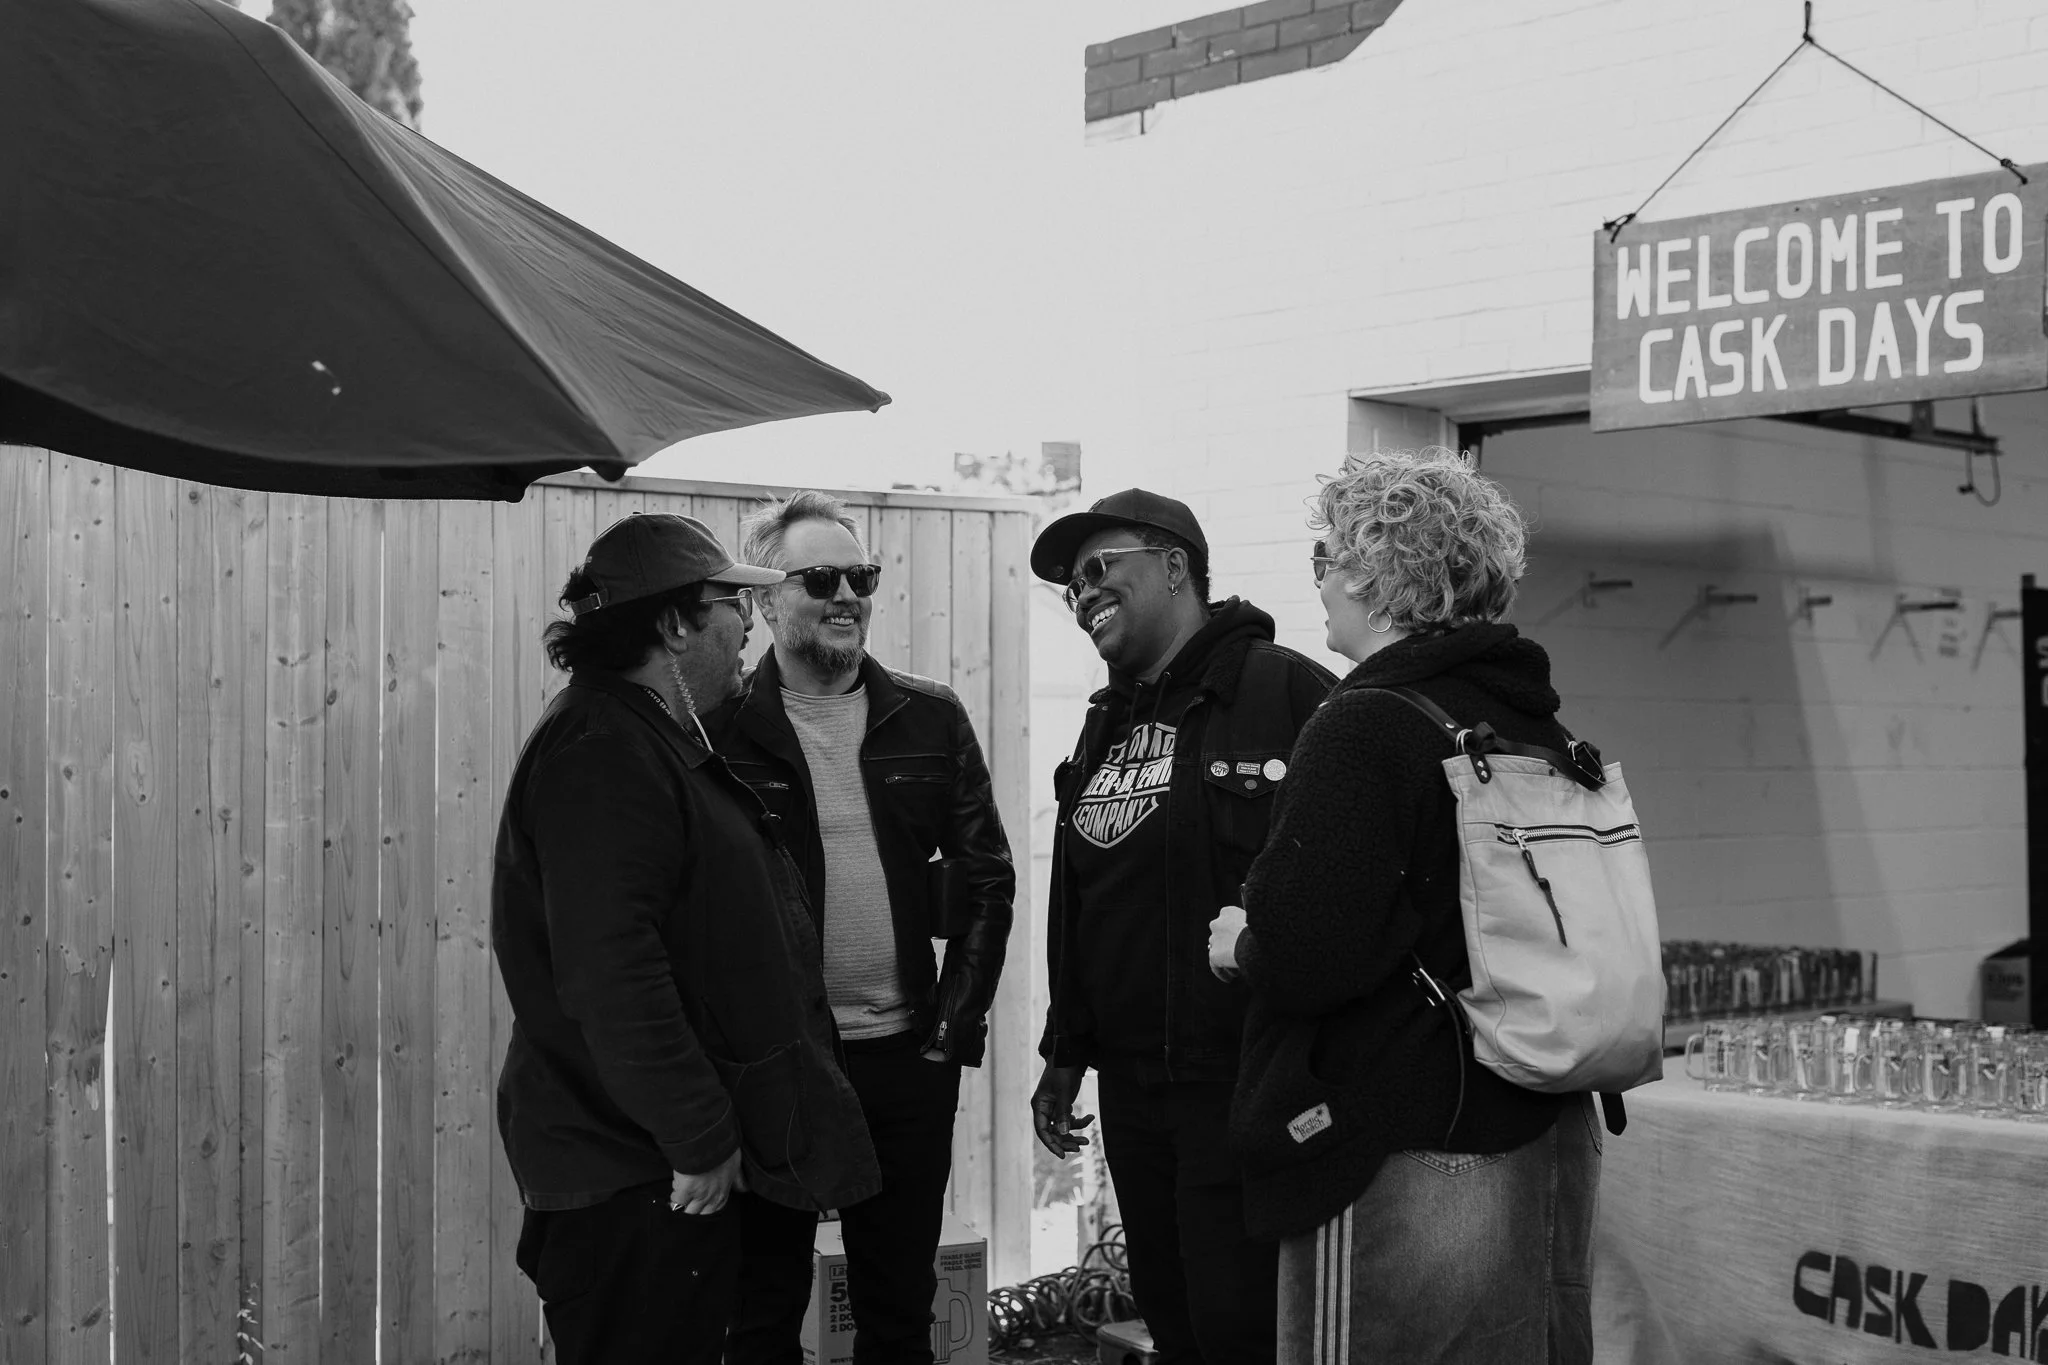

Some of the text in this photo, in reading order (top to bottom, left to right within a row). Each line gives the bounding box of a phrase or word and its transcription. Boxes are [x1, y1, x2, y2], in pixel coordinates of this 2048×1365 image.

[1616, 192, 2024, 320] WELCOME TO
[1638, 289, 1985, 404] CASK DAYS
[1077, 797, 1150, 842] COMPANY
[1293, 1115, 1320, 1134] Nordic
[1793, 1250, 2048, 1365] CASK DAY
